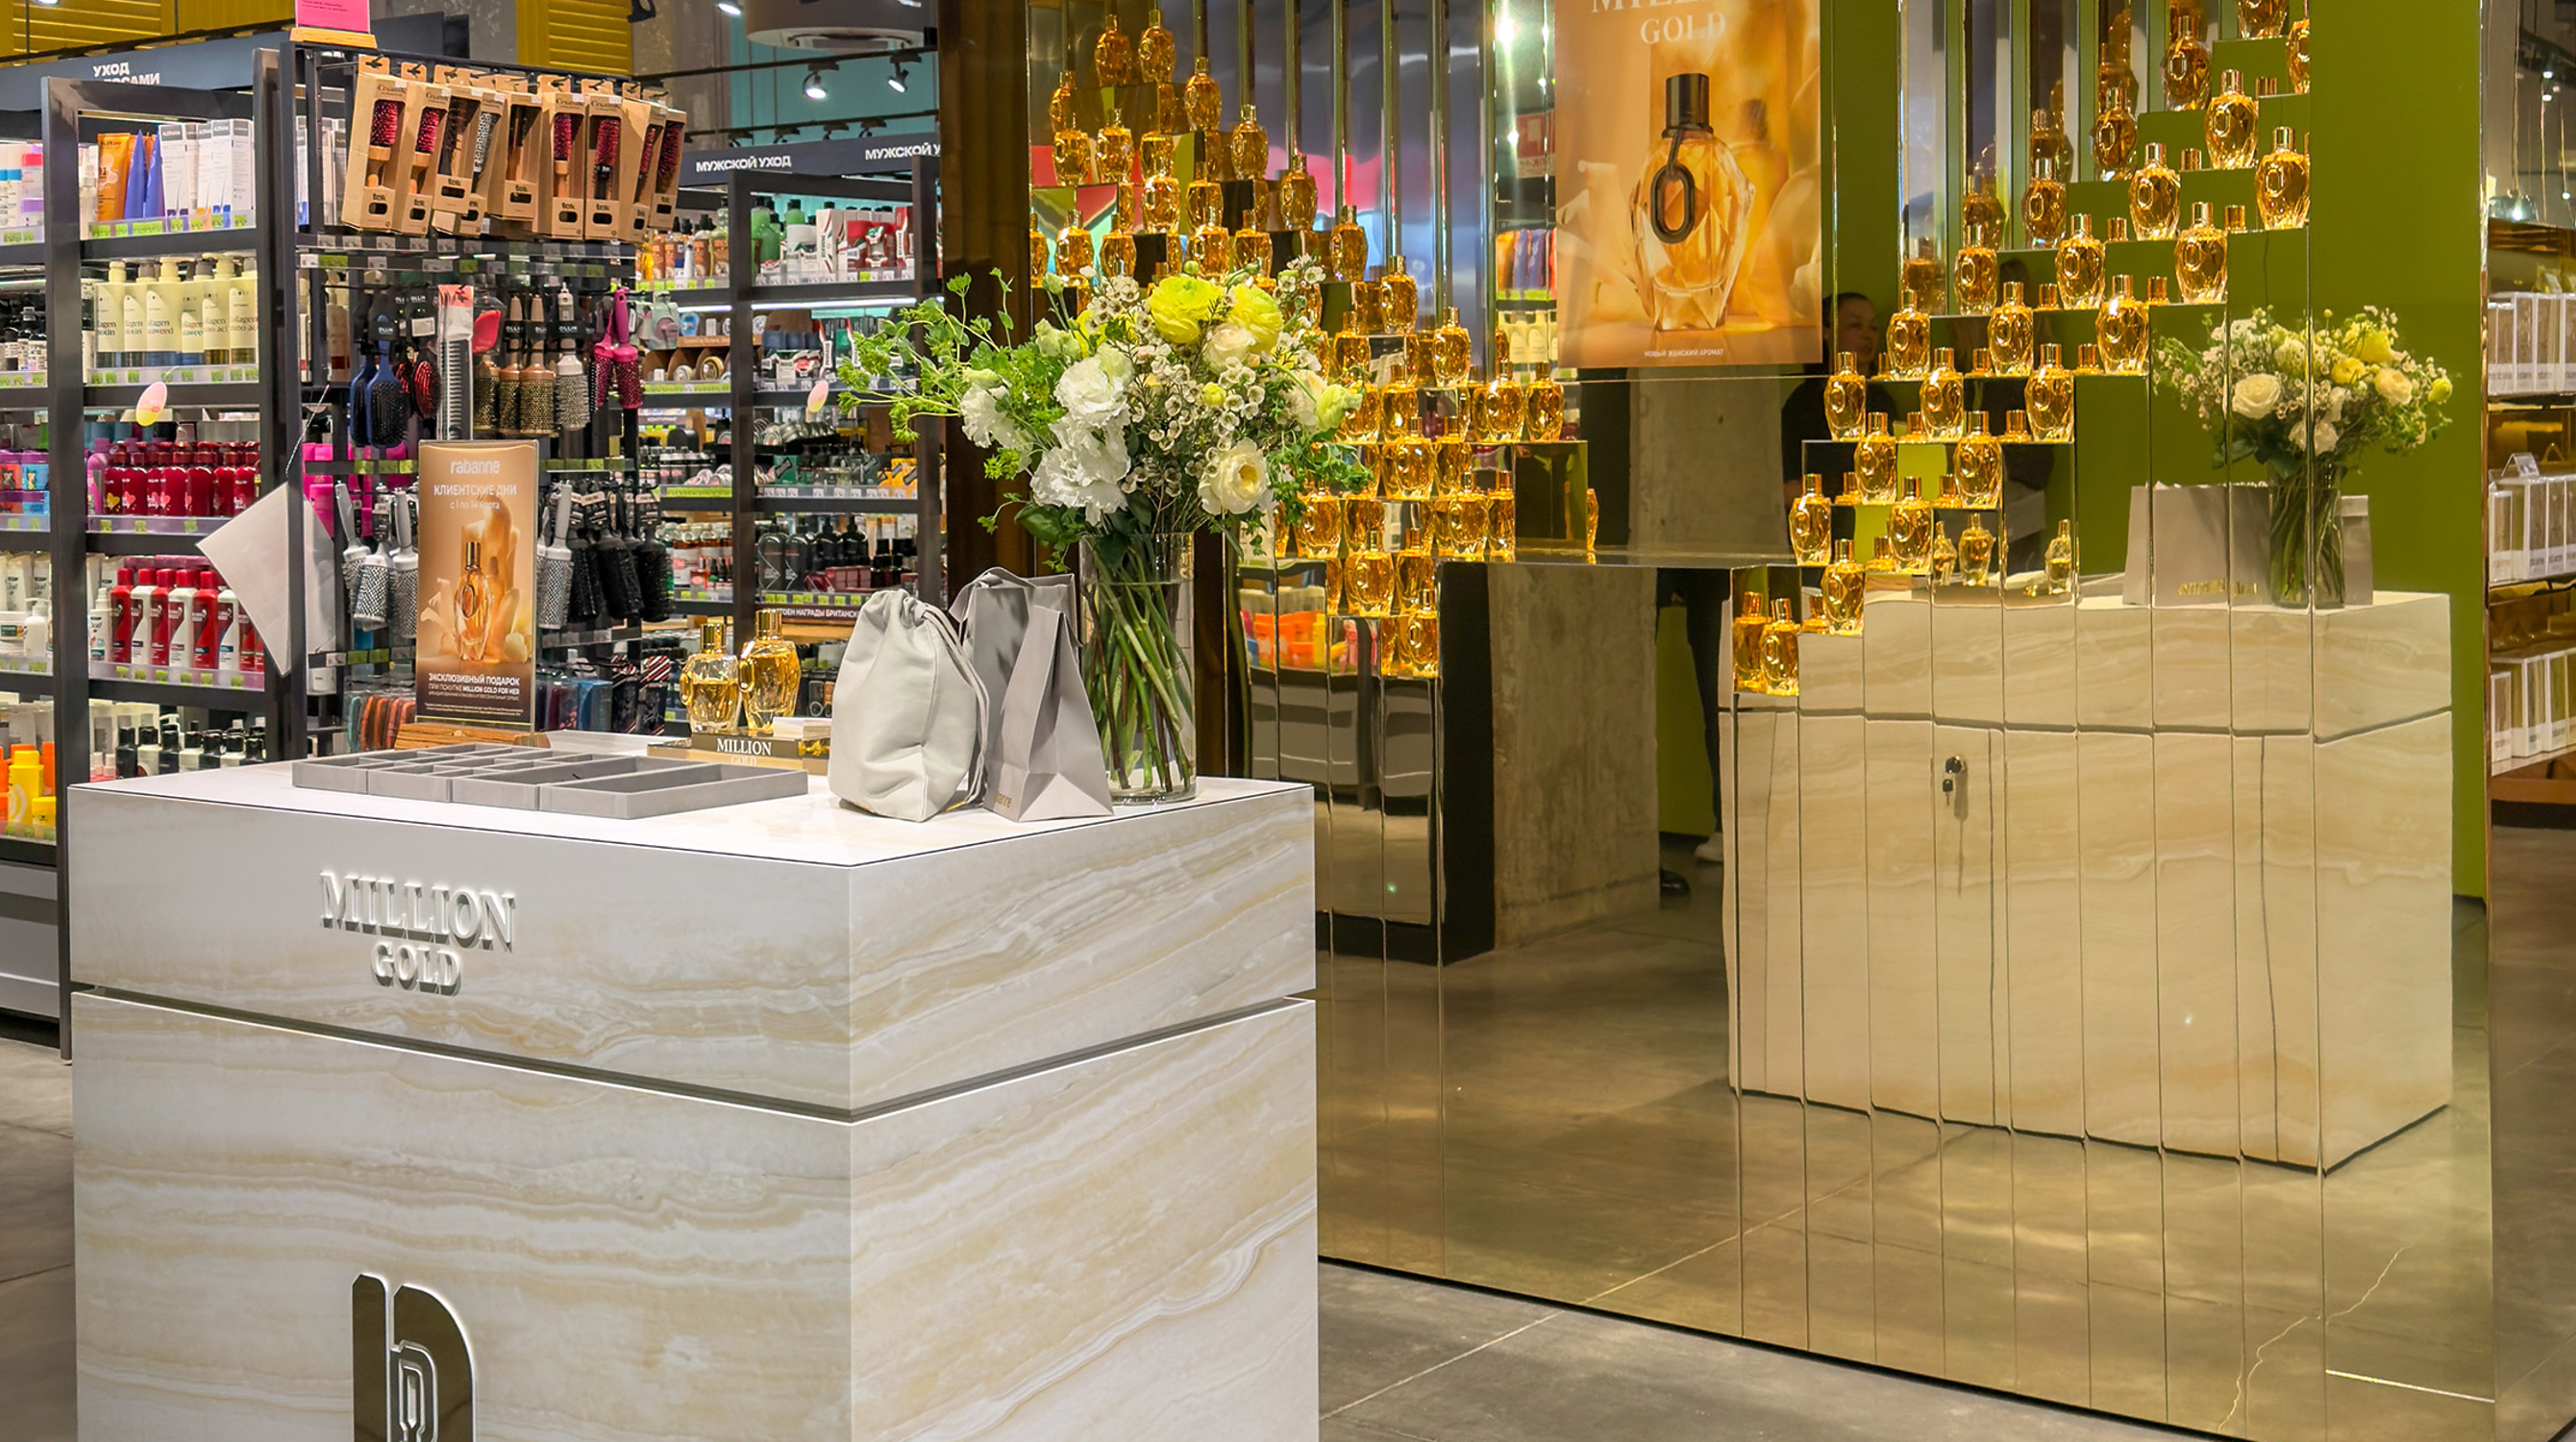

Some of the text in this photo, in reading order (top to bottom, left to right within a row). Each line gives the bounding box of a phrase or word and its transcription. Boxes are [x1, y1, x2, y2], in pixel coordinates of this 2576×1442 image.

[1640, 12, 1726, 44] GOLD
[92, 62, 130, 77] УХОД
[864, 141, 930, 161] МУЖСКОЙ
[695, 155, 791, 173] МУЖСКОЙ УХОД
[448, 178, 461, 186] tek
[562, 202, 576, 211] tek
[450, 460, 501, 475] rabanne
[433, 484, 517, 497] КЛИЕНТСКИЕ ДНИ
[796, 609, 825, 617] НАГРАДЫ
[428, 673, 520, 686] ЭКСКЛЮЗИВНЫЙ ПОДАРОК
[717, 737, 772, 756] MILLION
[731, 756, 757, 766] GOLD
[320, 872, 515, 950] MILLION
[371, 942, 461, 993] GOLD
